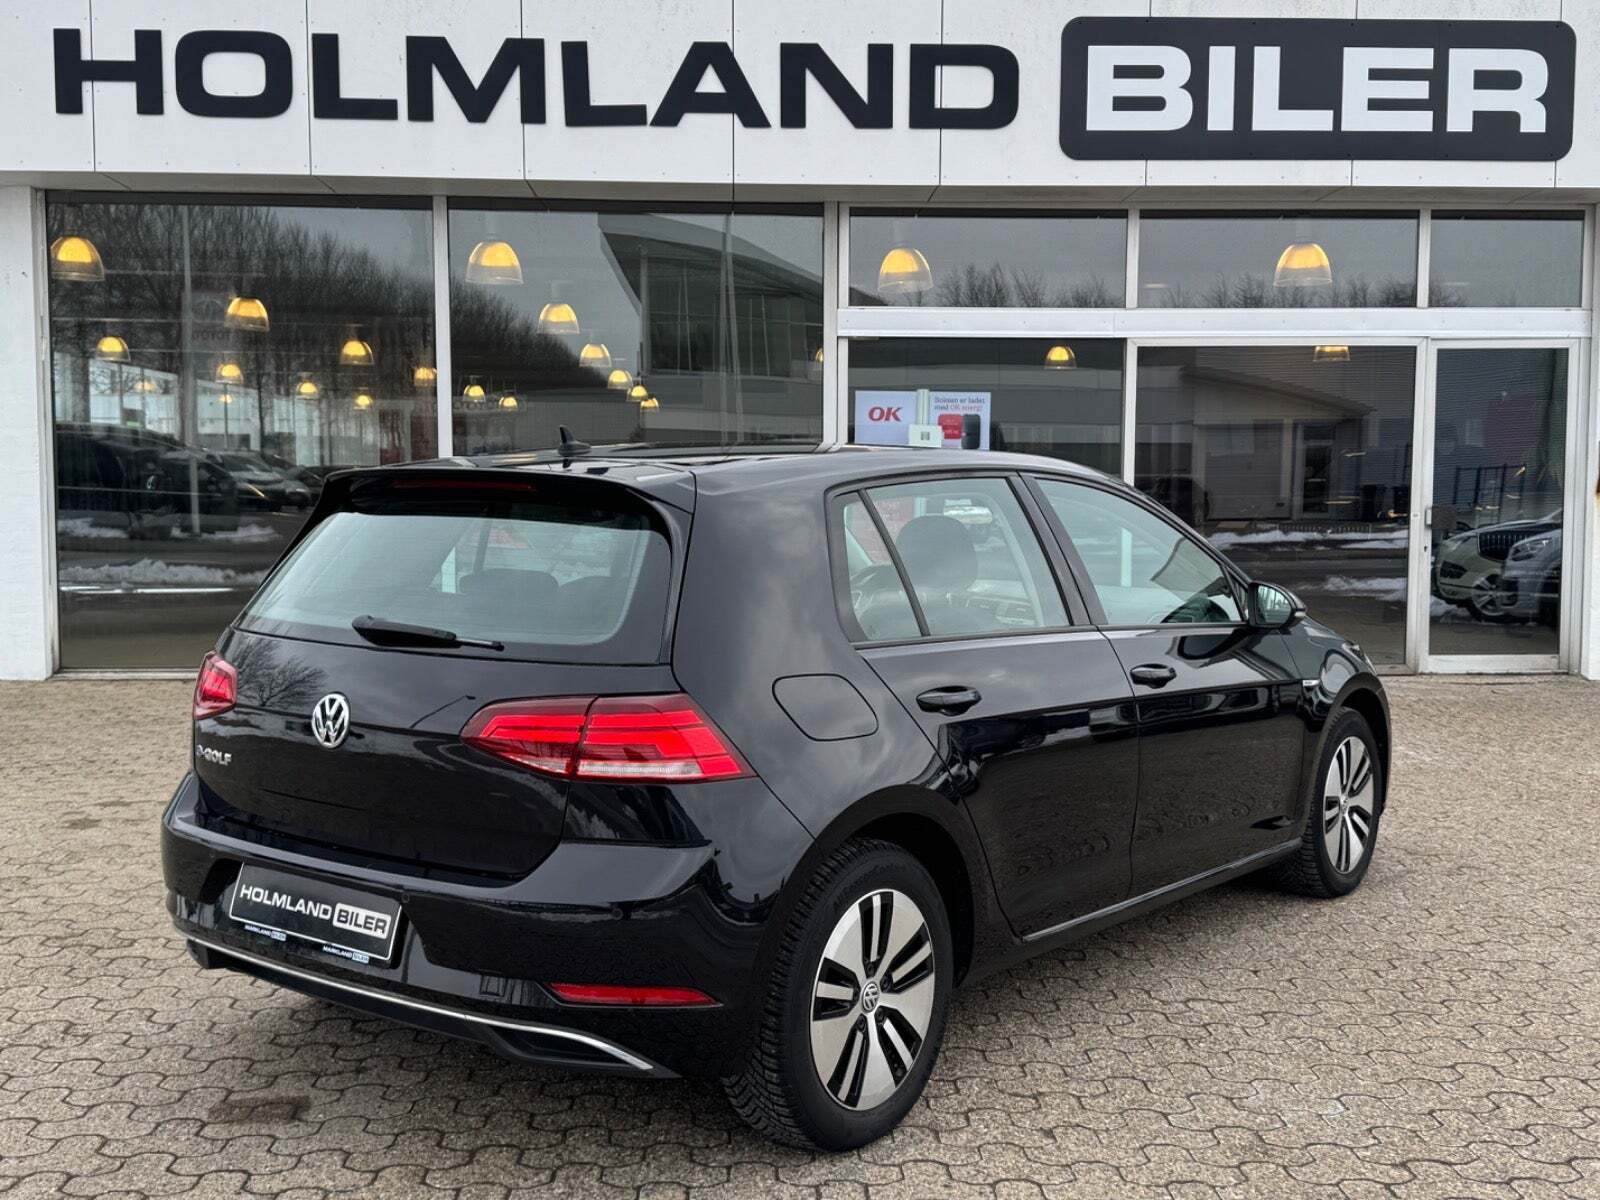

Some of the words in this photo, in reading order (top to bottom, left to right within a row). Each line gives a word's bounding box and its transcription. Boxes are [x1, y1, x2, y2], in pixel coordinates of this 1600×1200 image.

[54, 28, 1020, 129] HOLMLAND
[1085, 45, 1549, 134] BILER
[868, 406, 903, 422] OK
[239, 884, 332, 920] HOLMLAND
[336, 908, 388, 933] BILER
